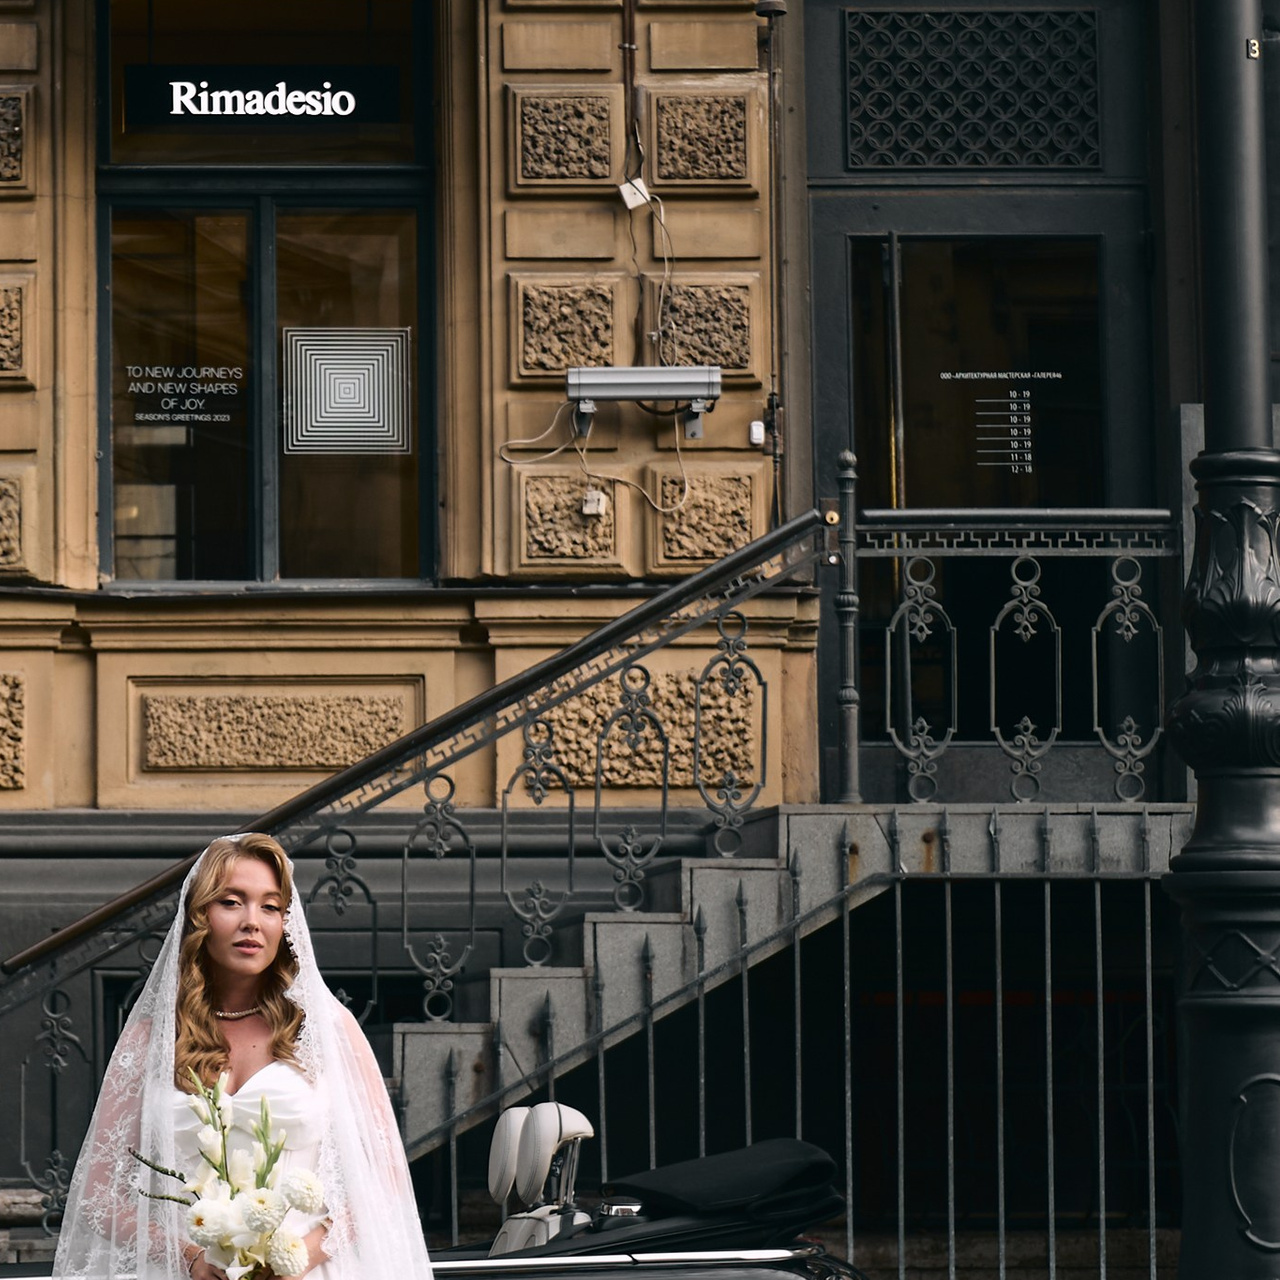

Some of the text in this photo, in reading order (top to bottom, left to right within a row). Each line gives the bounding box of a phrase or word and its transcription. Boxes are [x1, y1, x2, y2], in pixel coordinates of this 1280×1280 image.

[1250, 39, 1260, 58] 3
[168, 81, 356, 116] Rimadesio
[125, 366, 243, 380] TO NEW JOURNEYS
[127, 382, 238, 396] AND NEW SHAPES
[1009, 390, 1017, 399] 10
[1022, 390, 1030, 399] 19
[160, 398, 179, 410] OF
[1009, 403, 1017, 411] 10
[1023, 403, 1030, 411] 19
[171, 413, 212, 422] GREETINGS
[212, 414, 231, 422] 2023
[1010, 415, 1018, 424] 10
[1023, 415, 1031, 424] 19
[1010, 428, 1018, 436] 10
[1024, 428, 1031, 436] 19
[1011, 440, 1019, 449] 10
[1024, 440, 1032, 449] 19
[1011, 453, 1019, 462] 11
[1024, 453, 1032, 462] 18
[1011, 466, 1019, 474] 12
[1025, 466, 1032, 474] 18
